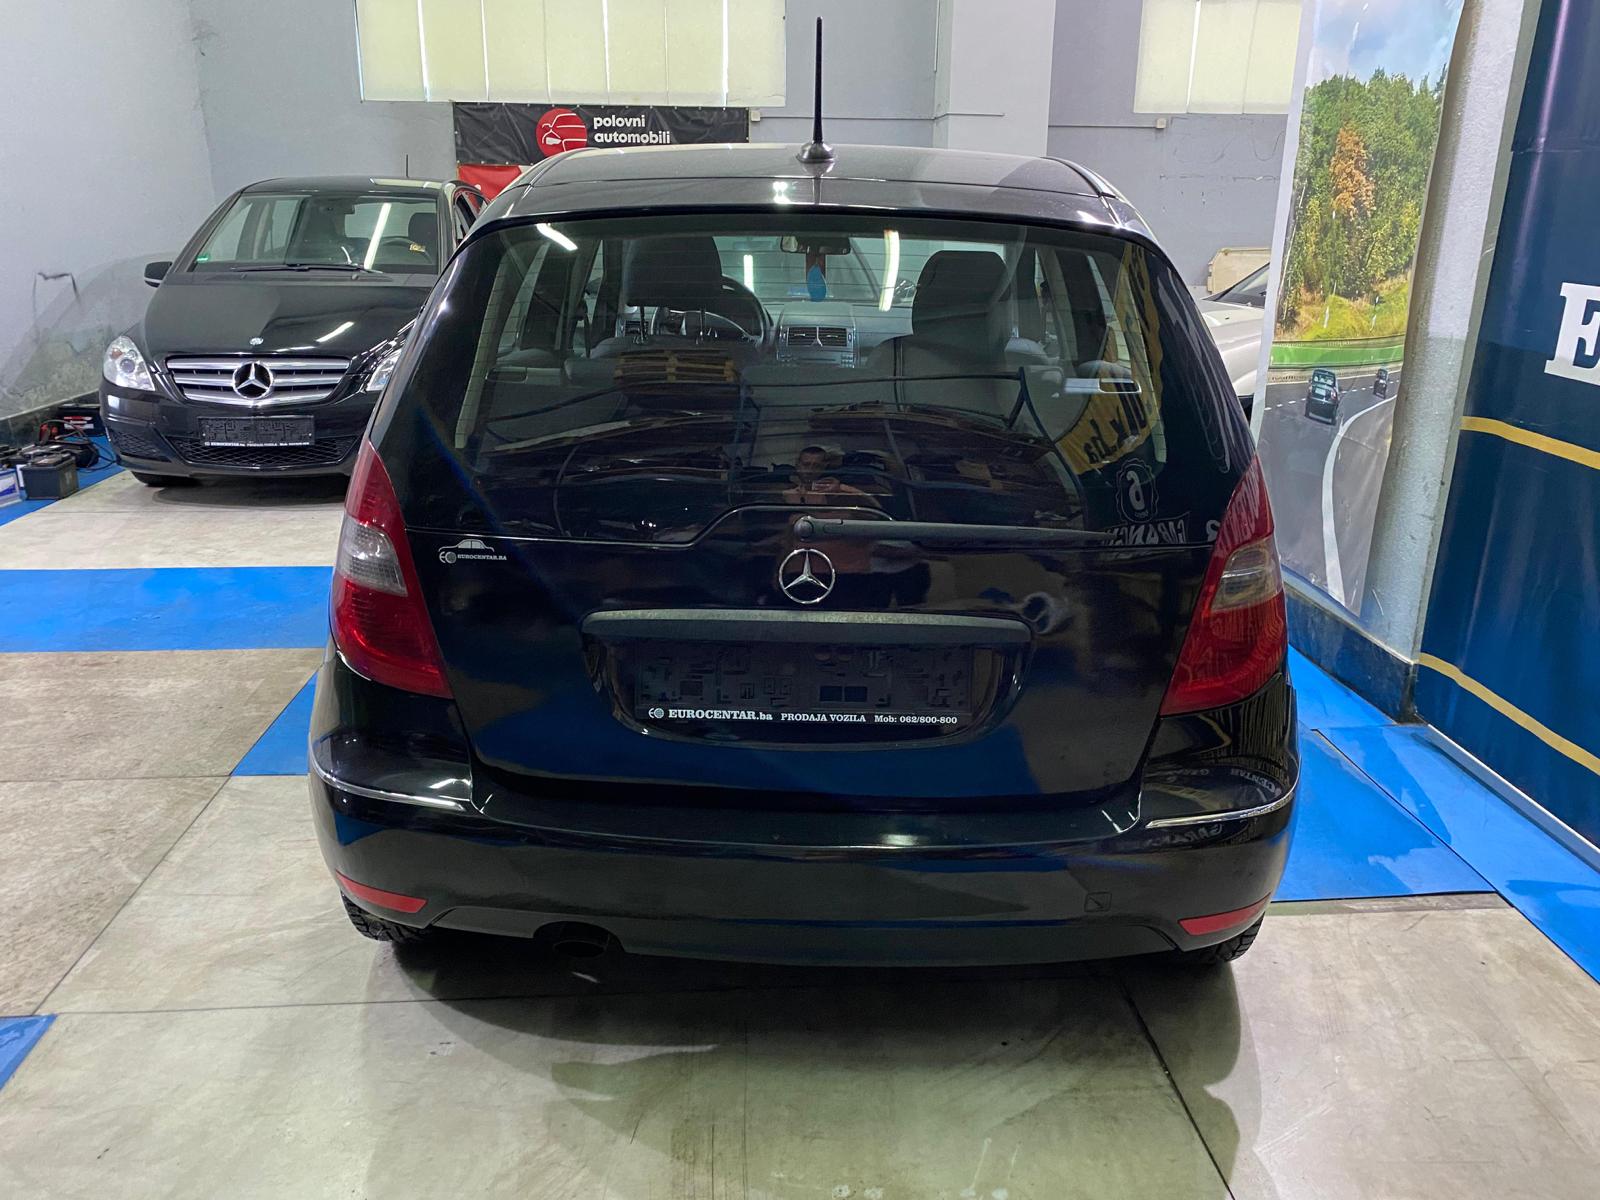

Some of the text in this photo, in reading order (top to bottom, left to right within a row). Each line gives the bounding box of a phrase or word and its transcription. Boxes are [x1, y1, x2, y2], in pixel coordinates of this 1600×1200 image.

[593, 114, 646, 130] polovni
[594, 130, 671, 144] automobili
[668, 708, 958, 725] EUROCENTAR.ba PRODAJA VOZILA Mob: 062/800-800
